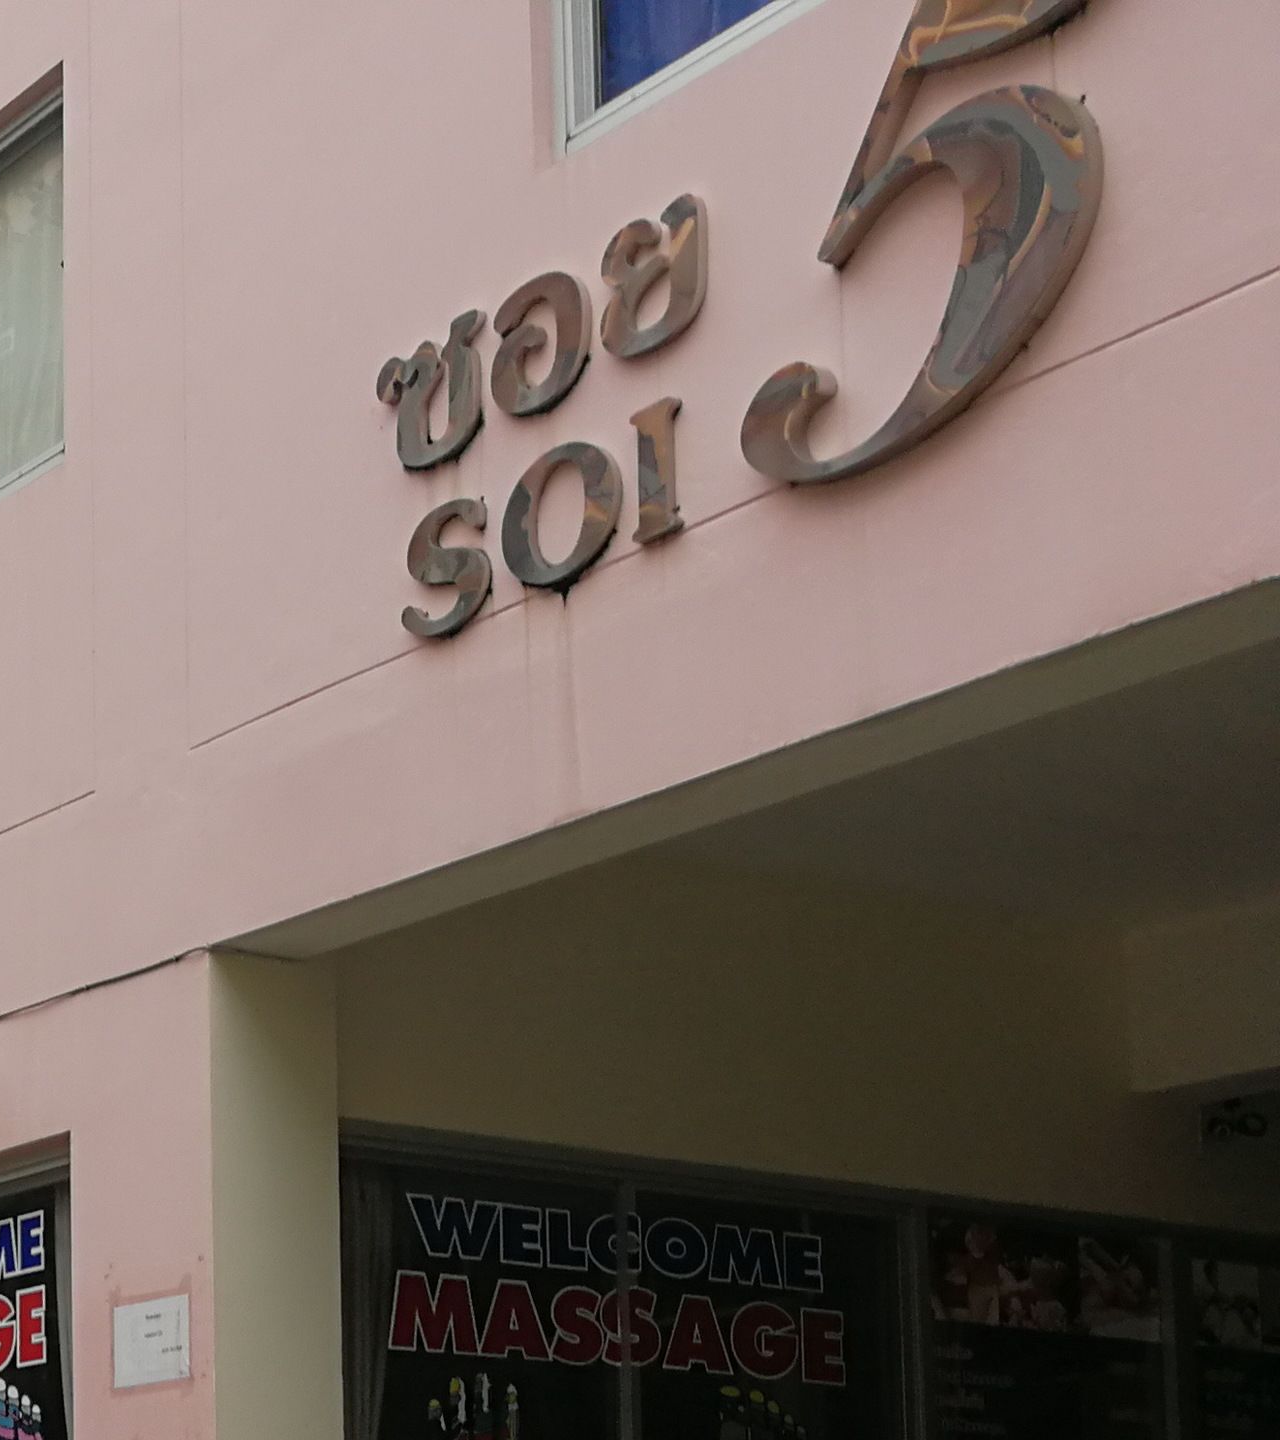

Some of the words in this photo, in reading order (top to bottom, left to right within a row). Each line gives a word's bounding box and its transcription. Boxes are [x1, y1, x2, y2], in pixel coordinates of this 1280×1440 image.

[376, 192, 709, 472] ซอย
[401, 396, 685, 638] SOI
[740, 0, 1105, 485] 5
[388, 1268, 846, 1387] MASSAGE
[405, 1192, 824, 1293] WELCOME
